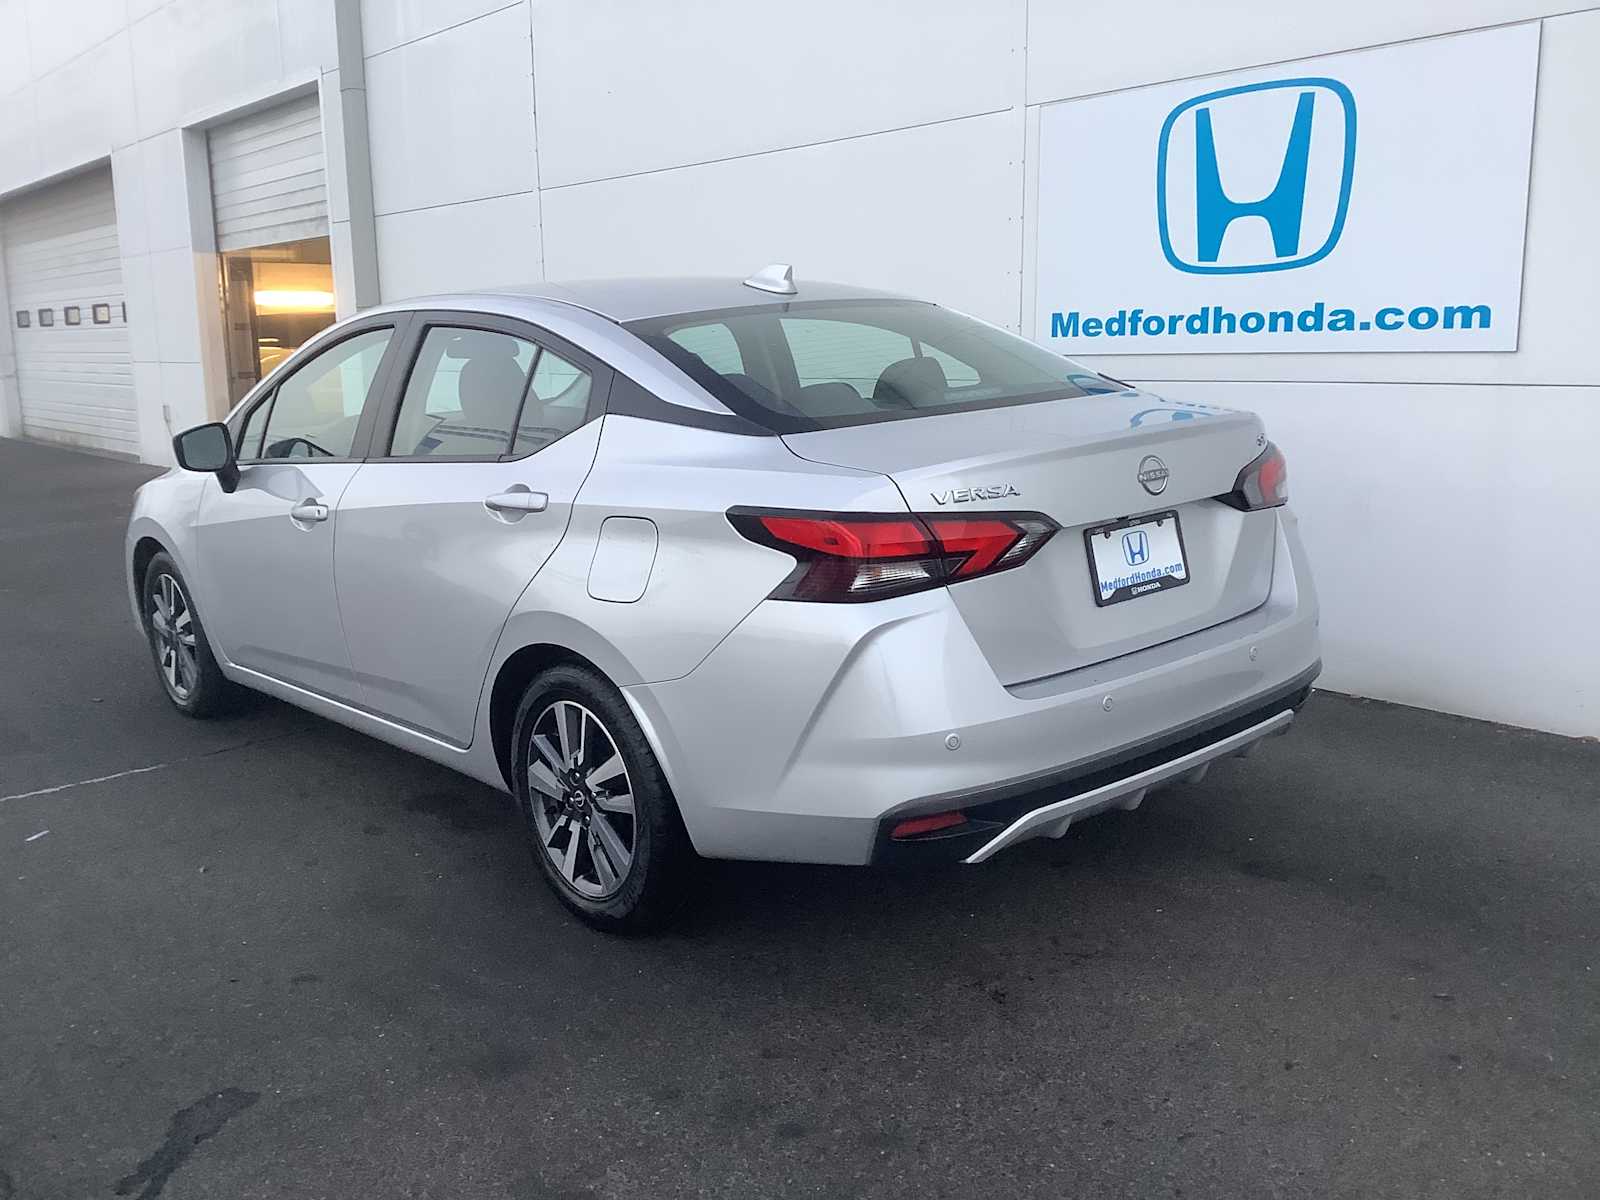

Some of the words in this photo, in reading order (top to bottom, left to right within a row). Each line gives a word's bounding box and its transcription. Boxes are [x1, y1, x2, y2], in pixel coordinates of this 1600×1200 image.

[1050, 302, 1492, 338] Medfordhonda.com
[930, 482, 1021, 506] VERSA
[1101, 563, 1183, 593] MedfordHonda.com
[1138, 581, 1161, 593] HONDA
